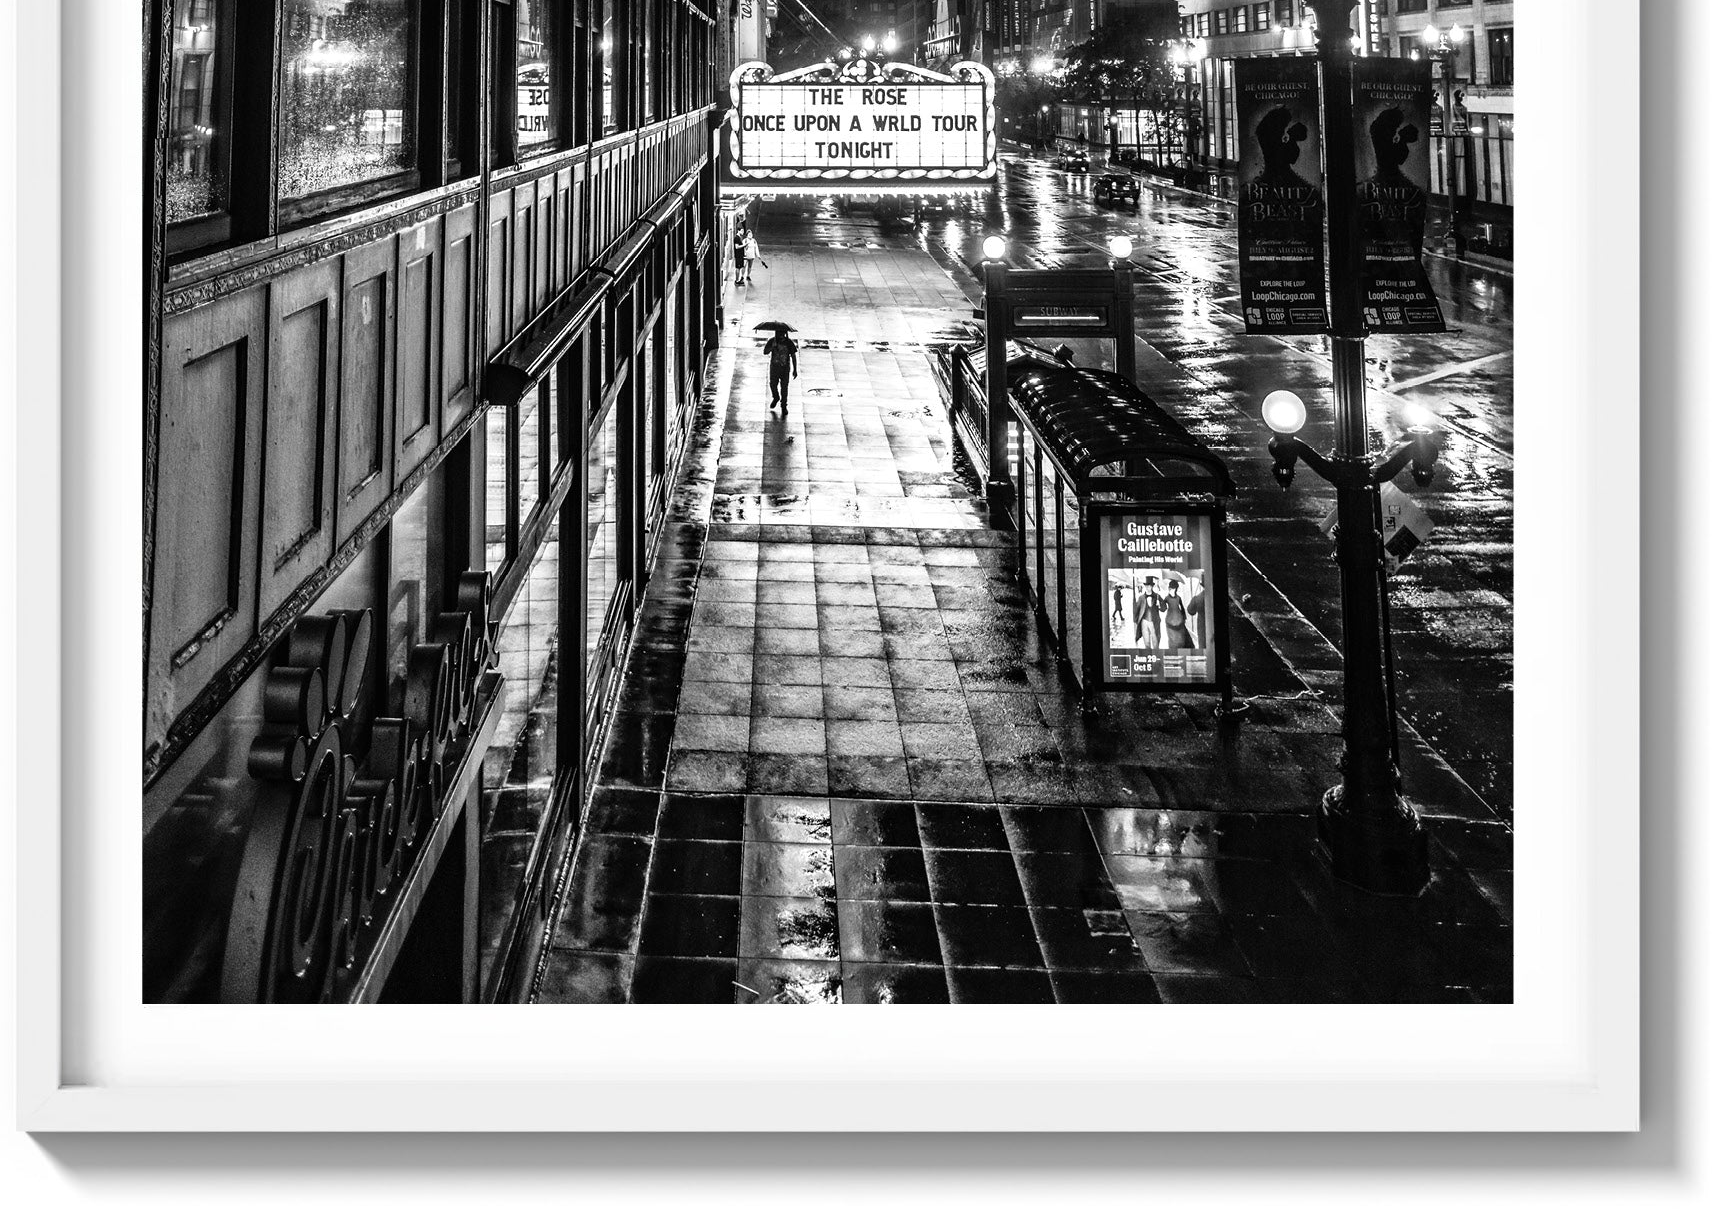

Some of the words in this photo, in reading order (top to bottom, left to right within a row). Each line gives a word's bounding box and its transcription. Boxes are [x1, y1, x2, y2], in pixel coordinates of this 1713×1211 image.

[809, 88, 844, 105] THE
[862, 88, 907, 105] ROSE
[743, 115, 785, 132] ONCE
[794, 115, 840, 132] UPON
[849, 115, 862, 132] A
[873, 115, 922, 132] WRLD
[931, 115, 978, 132] TOUR
[815, 141, 893, 159] TONIGHT
[1251, 291, 1316, 302] LoopChicago.com
[1040, 306, 1079, 316] SUBWAY
[1266, 312, 1285, 321] LOOP
[1382, 312, 1402, 321] LOOP
[1127, 522, 1183, 536] Gustave
[1117, 538, 1193, 552] Caillebotte
[1128, 556, 1154, 564] Painting
[1133, 655, 1147, 663] Jun
[1133, 663, 1146, 671] Oct
[1146, 663, 1152, 671] 5
